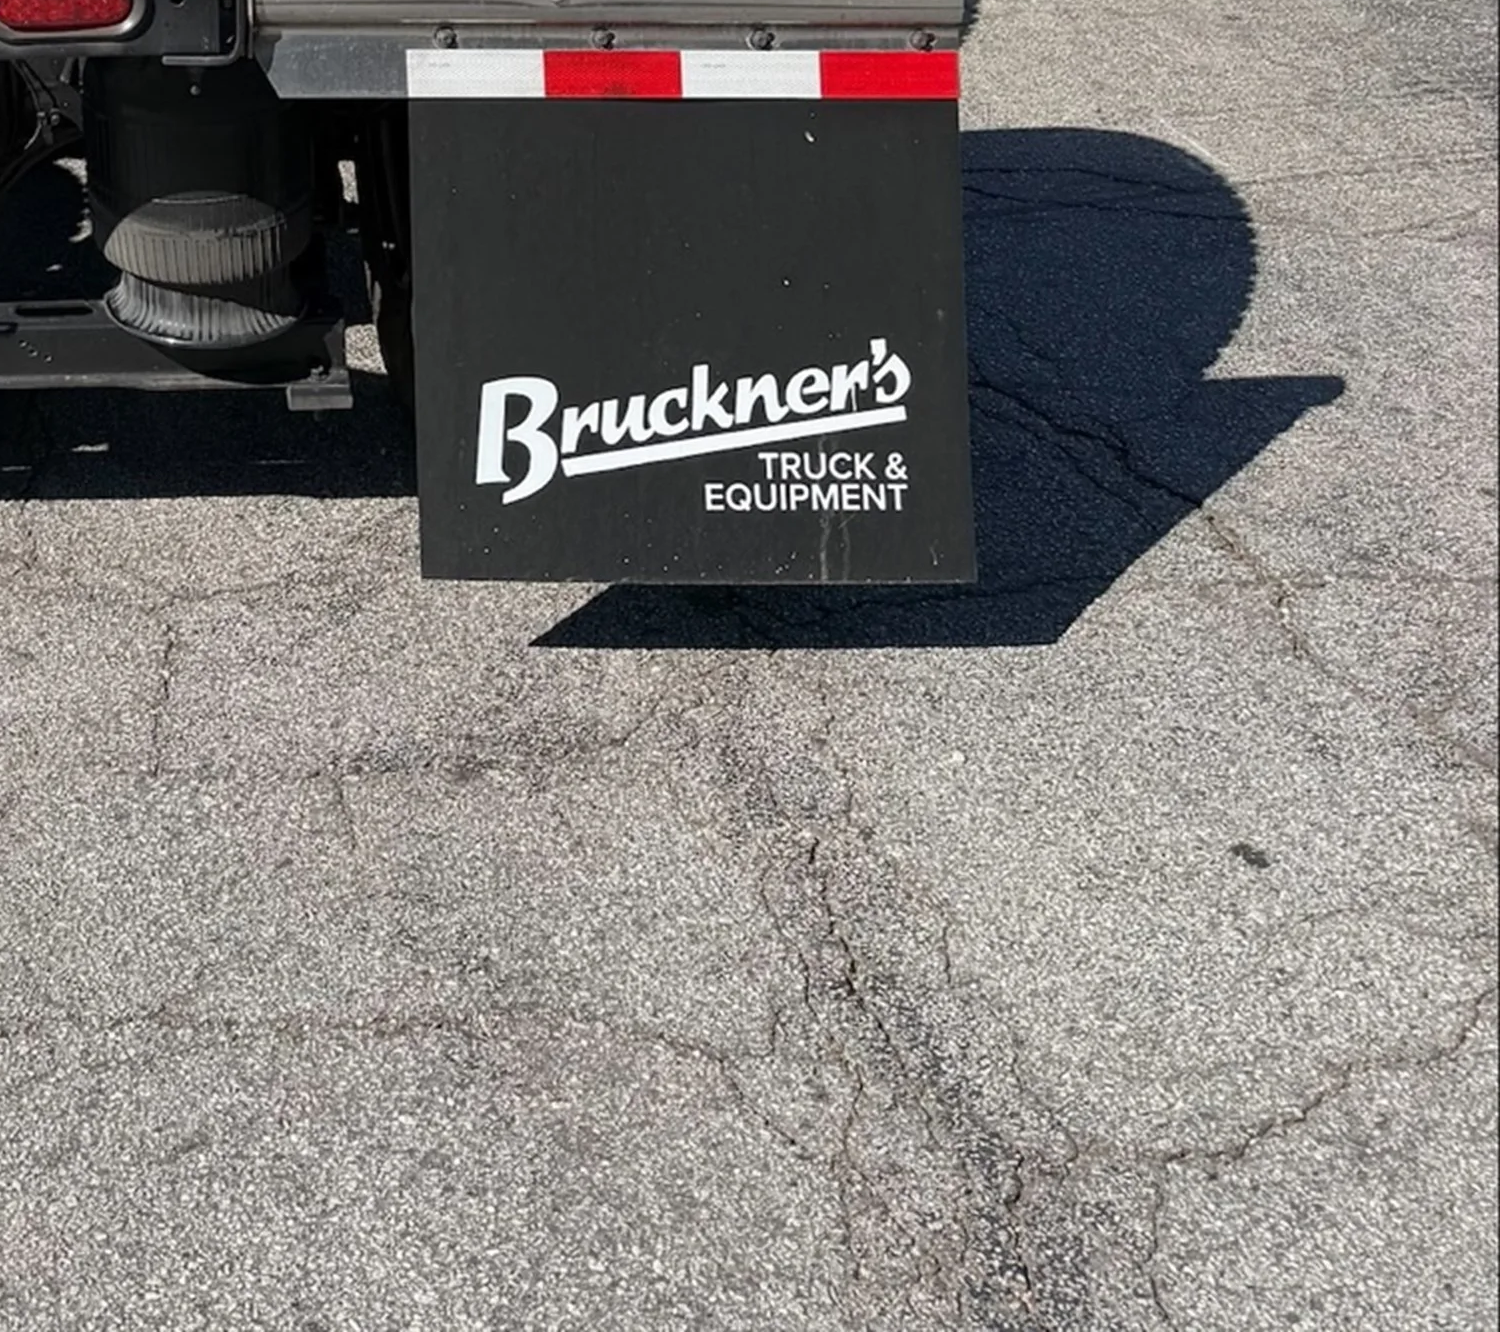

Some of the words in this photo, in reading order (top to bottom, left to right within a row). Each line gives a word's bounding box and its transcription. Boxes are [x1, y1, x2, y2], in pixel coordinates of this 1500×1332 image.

[475, 338, 912, 505] Bruckner's
[758, 451, 875, 480] TRUCK
[884, 452, 909, 480] &
[704, 483, 909, 512] EQUIPMENT
